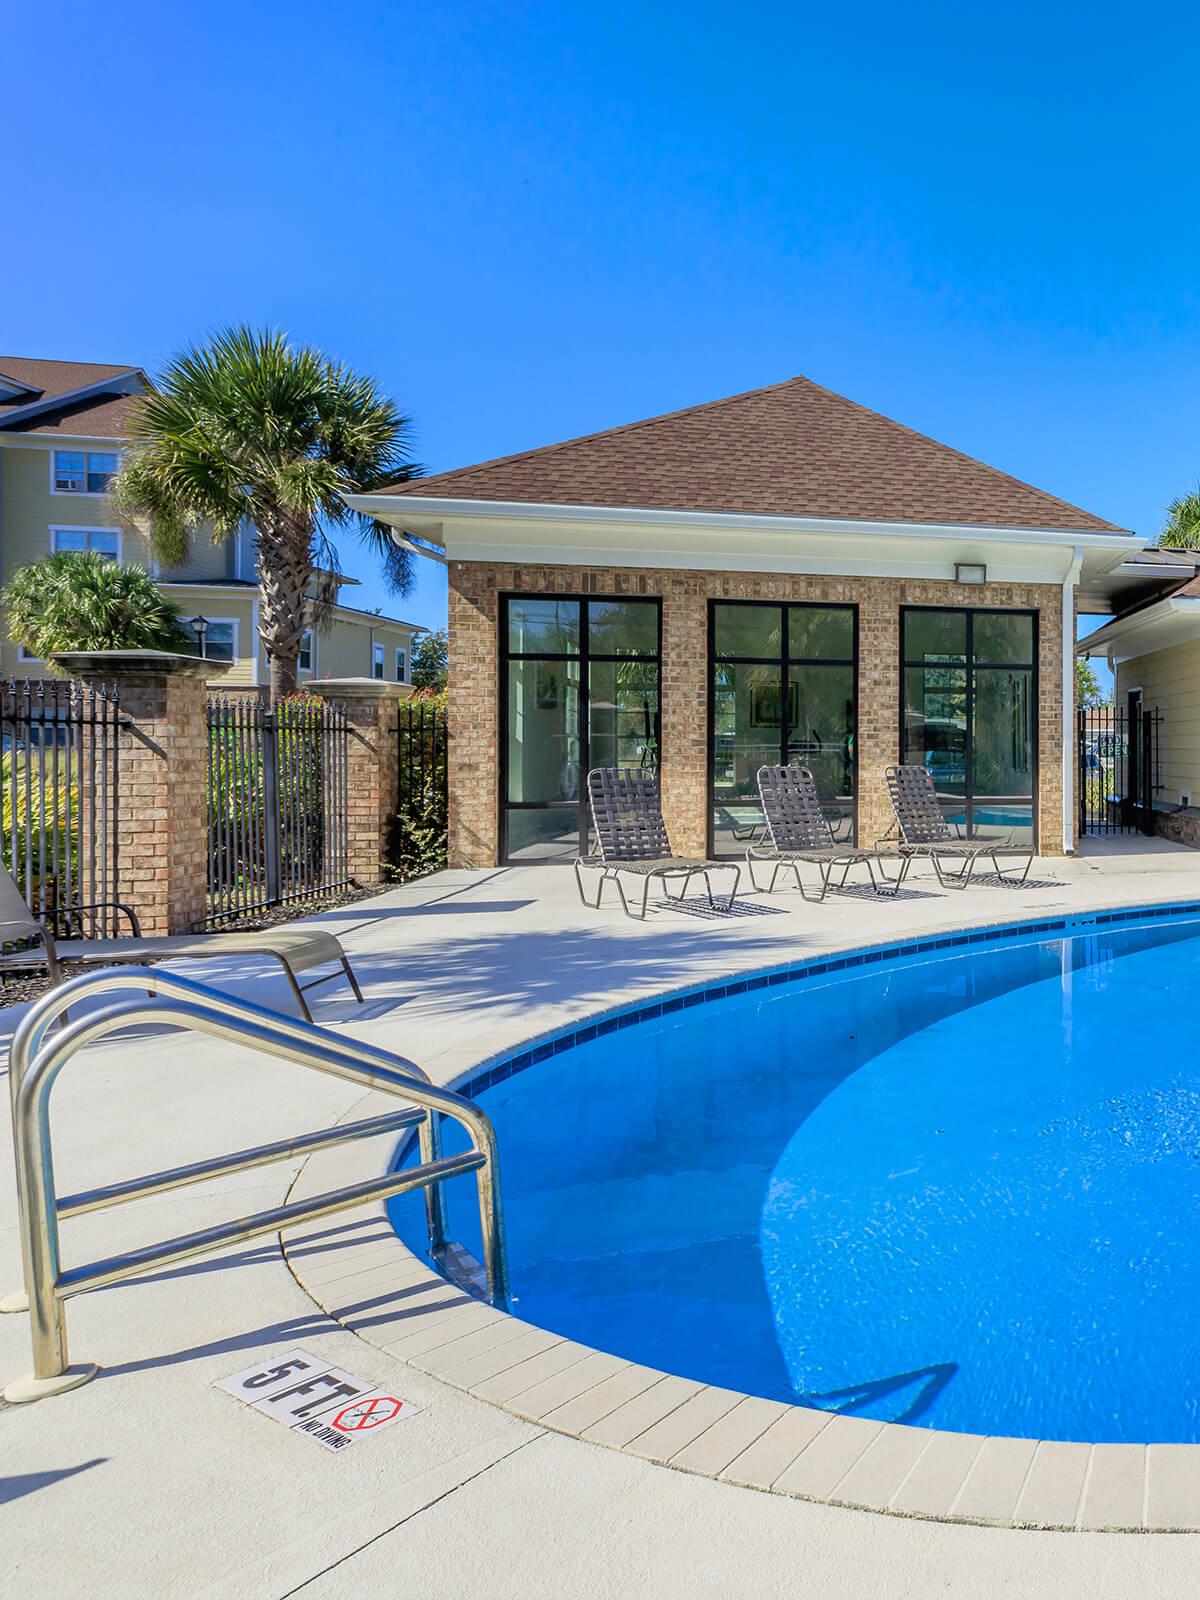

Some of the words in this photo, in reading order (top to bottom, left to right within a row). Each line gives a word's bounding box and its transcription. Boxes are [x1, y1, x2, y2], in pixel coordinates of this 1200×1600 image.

[242, 1358, 311, 1389] 5
[299, 1419, 324, 1432] NO
[313, 1426, 352, 1449] DIVING
